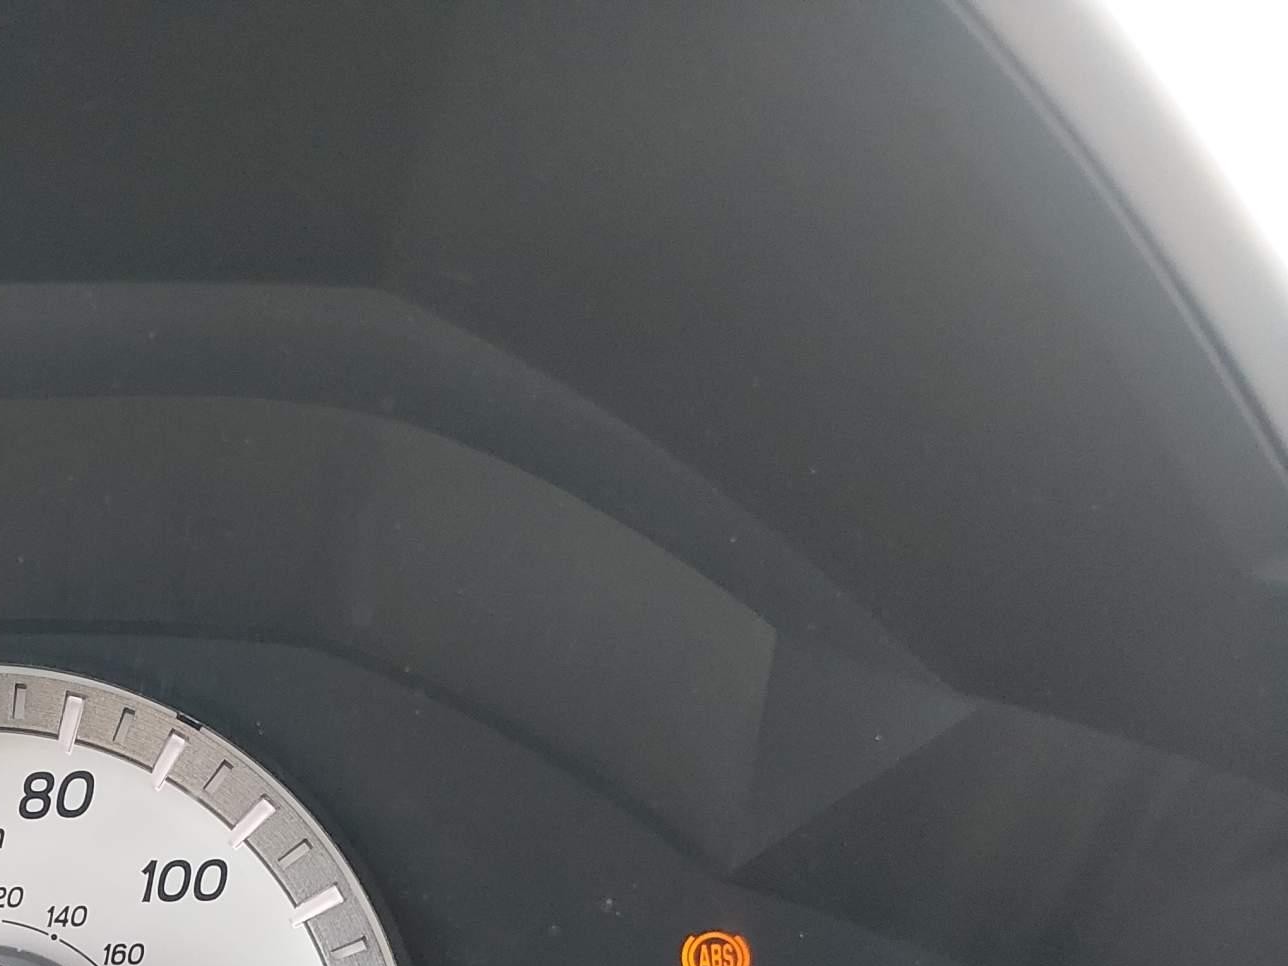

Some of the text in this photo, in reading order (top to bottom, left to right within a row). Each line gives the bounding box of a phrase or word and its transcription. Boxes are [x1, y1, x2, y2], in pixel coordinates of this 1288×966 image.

[18, 770, 94, 819] 80
[141, 859, 228, 903] 100
[47, 906, 87, 928] 140
[103, 943, 145, 966] 160
